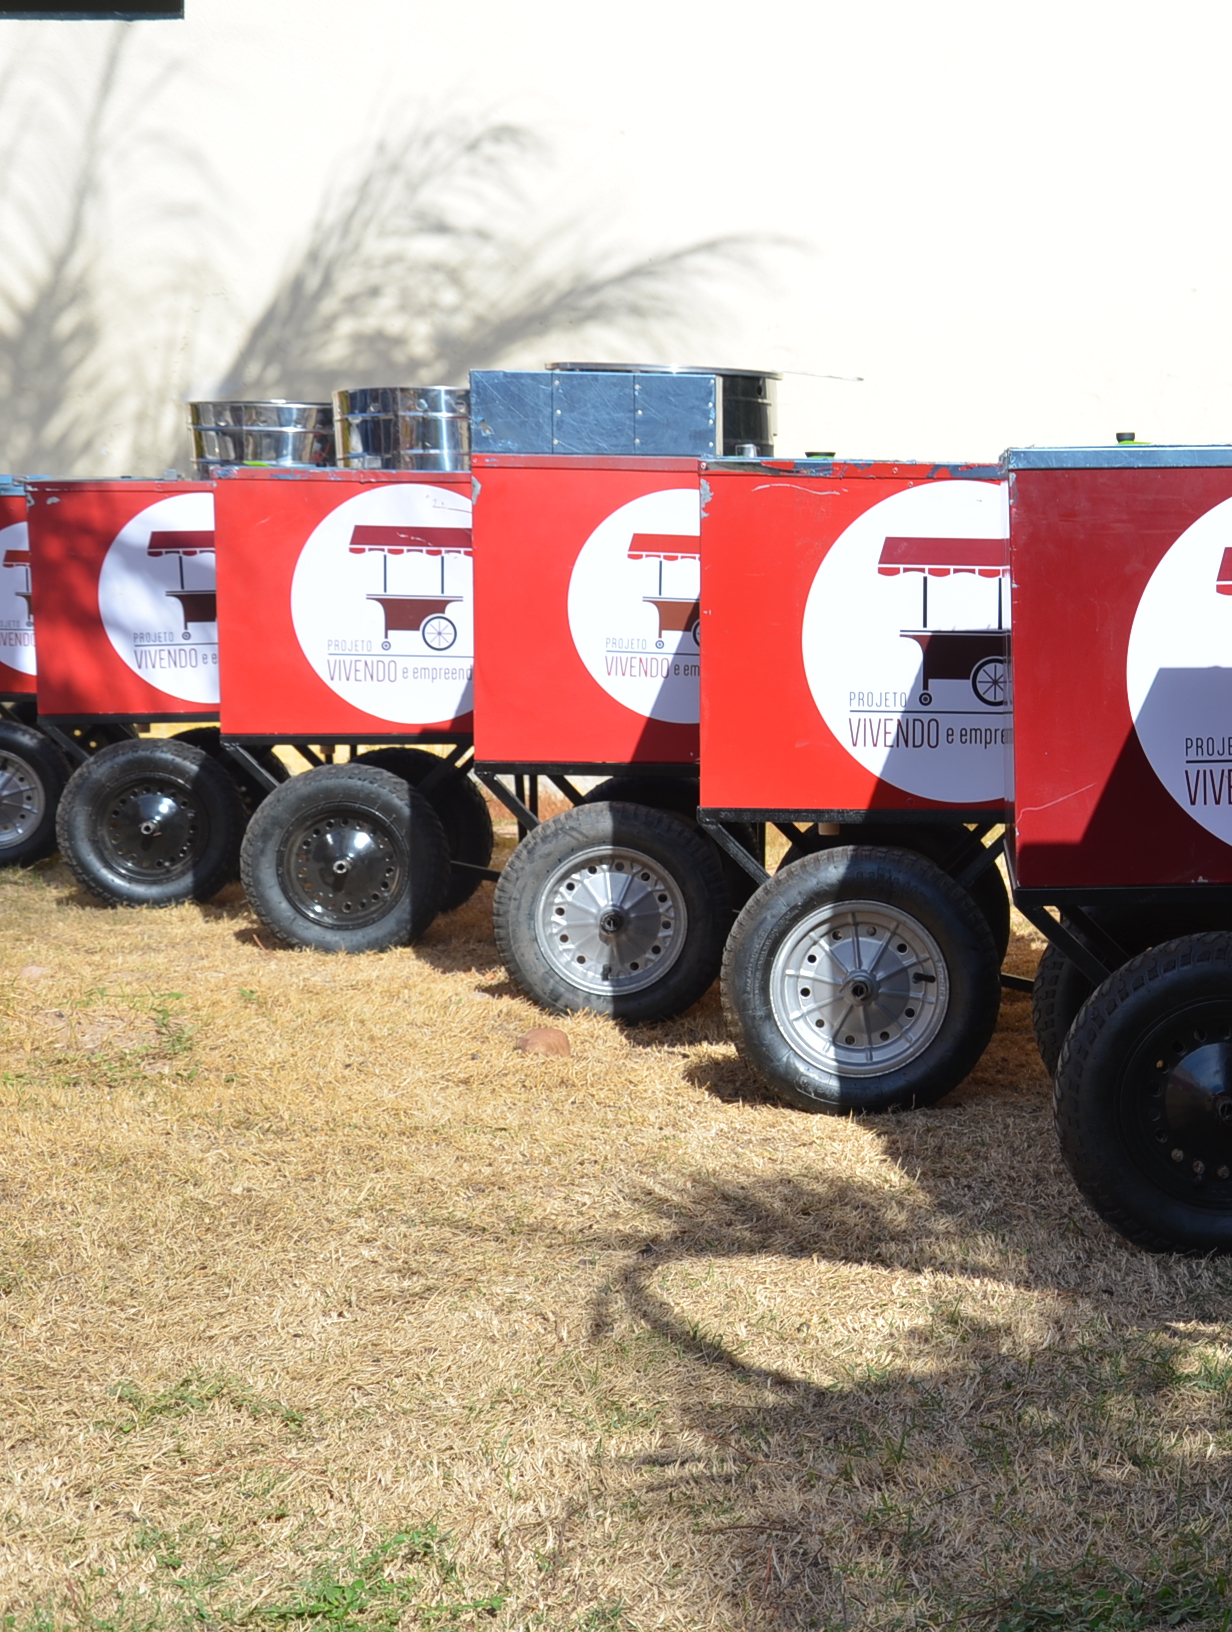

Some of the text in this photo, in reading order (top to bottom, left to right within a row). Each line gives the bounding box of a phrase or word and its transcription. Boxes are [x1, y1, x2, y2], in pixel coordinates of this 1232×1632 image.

[133, 632, 174, 643] PROJETO
[327, 639, 372, 652] PROJETO
[605, 637, 647, 650] PROJETO
[134, 648, 198, 669] VIVENDO
[202, 653, 208, 665] e
[605, 656, 670, 679] VIVENDO
[674, 664, 680, 676] e
[327, 659, 397, 683] VIVENDO
[402, 667, 409, 679] e
[849, 691, 908, 708] PROJETO
[849, 718, 939, 749] VIVENDO
[946, 727, 954, 744] e
